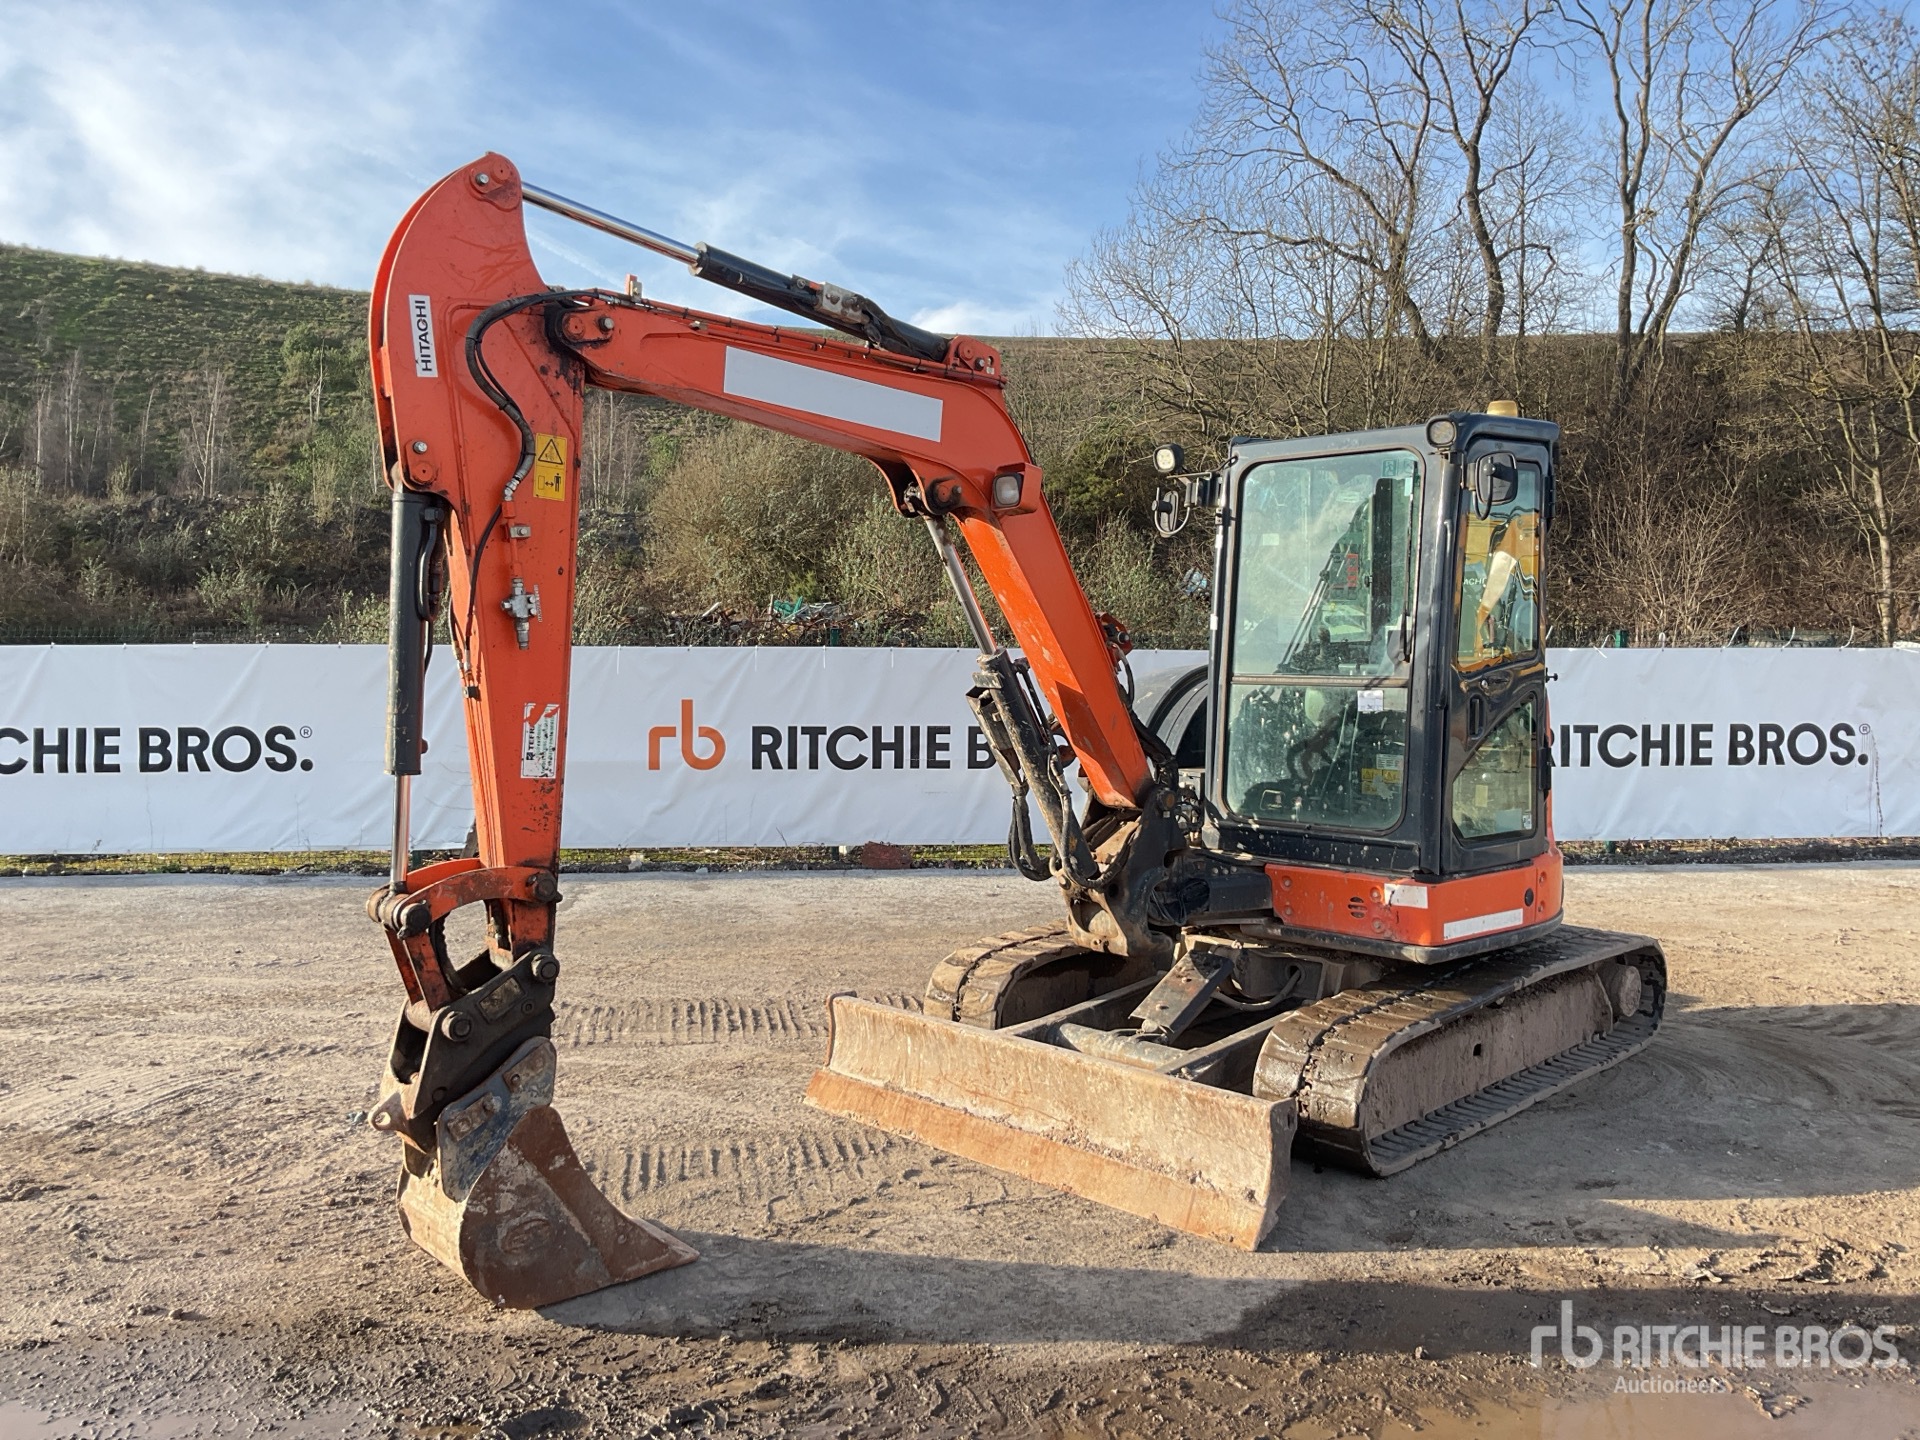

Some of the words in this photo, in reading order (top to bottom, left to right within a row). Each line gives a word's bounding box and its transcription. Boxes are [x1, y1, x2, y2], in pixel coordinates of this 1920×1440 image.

[415, 300, 433, 371] HITACHI
[751, 725, 951, 770] RITCHIE
[1550, 723, 1713, 768] ITCHIE
